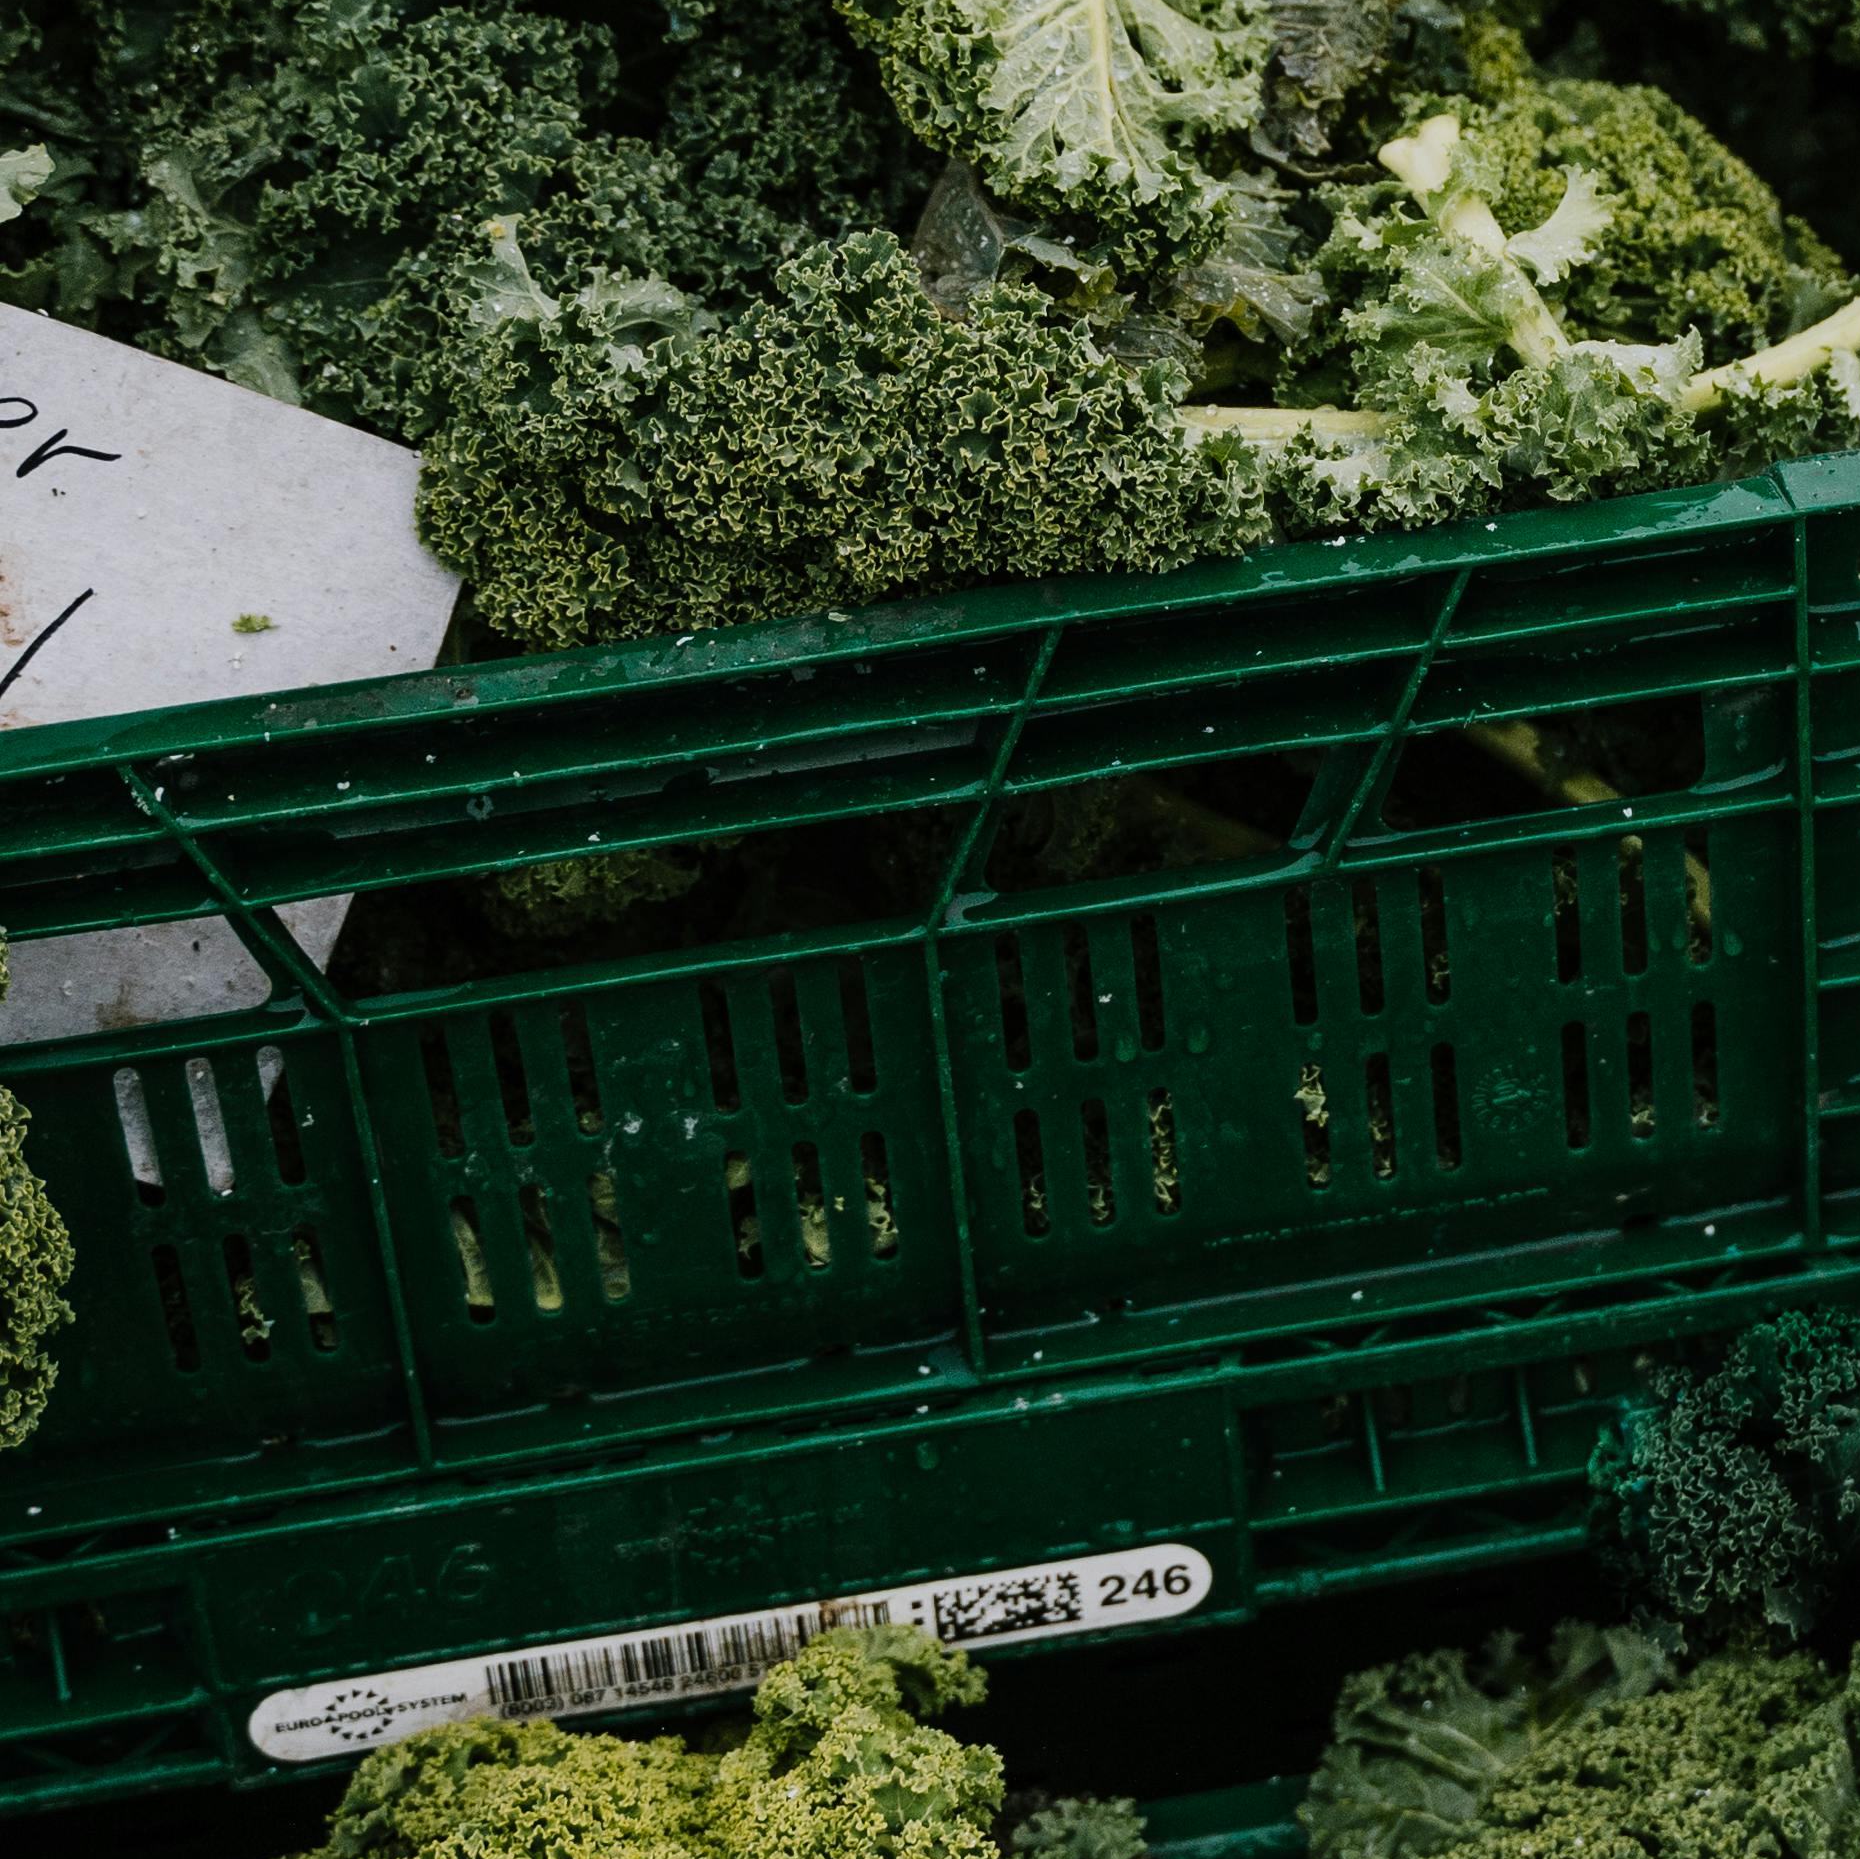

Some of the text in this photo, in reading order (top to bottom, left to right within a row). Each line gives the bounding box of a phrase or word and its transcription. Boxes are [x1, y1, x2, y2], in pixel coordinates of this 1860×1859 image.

[1099, 1563, 1192, 1607] 246
[275, 1692, 468, 1734] EURO POOL SYSTEM
